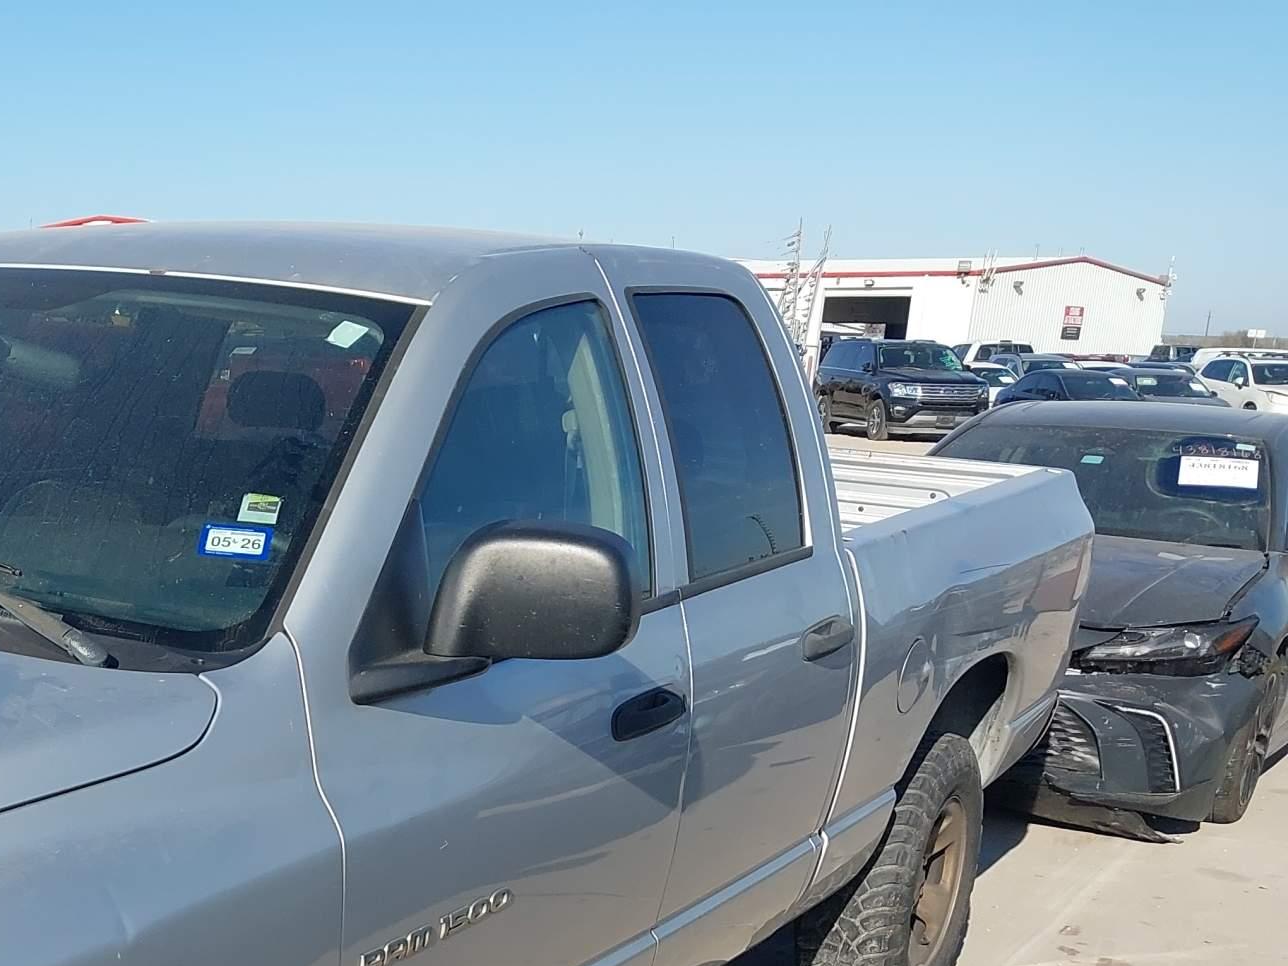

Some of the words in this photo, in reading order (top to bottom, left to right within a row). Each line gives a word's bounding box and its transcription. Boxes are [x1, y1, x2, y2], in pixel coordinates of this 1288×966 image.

[210, 536, 232, 548] 05
[240, 537, 263, 550] 26
[439, 887, 513, 940] 1500
